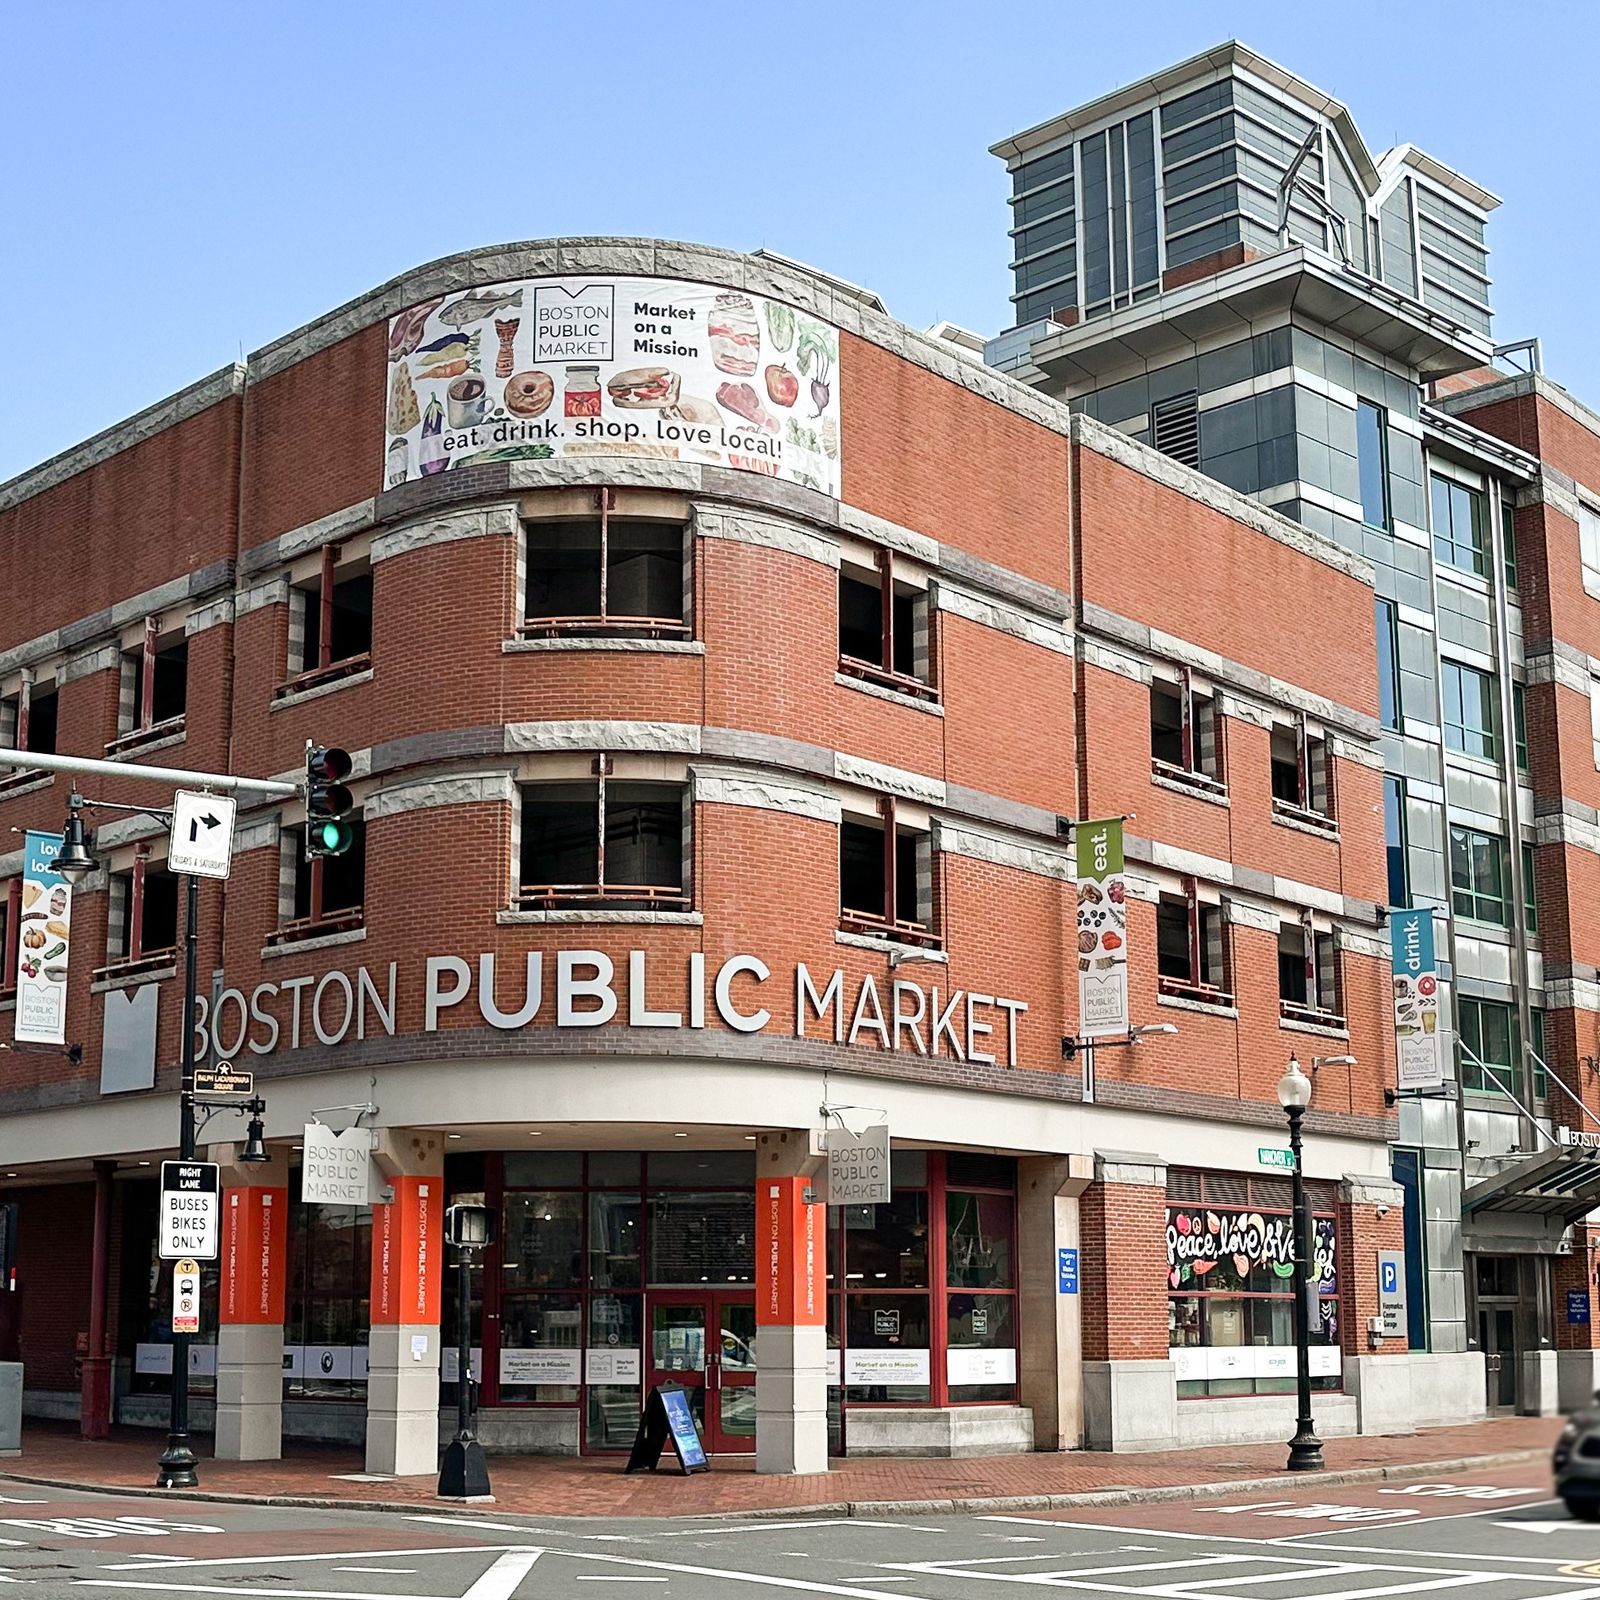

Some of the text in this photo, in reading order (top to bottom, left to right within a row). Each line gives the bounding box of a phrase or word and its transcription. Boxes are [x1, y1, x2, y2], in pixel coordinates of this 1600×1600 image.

[539, 306, 609, 321] BOSTON
[633, 302, 697, 320] Market
[539, 324, 600, 339] PUBLIC
[634, 322, 672, 335] on a
[538, 342, 608, 356] MARKET
[633, 339, 698, 357] Mission
[443, 417, 782, 459] eat. drink. shop. love local!
[40, 841, 61, 856] lov
[1091, 828, 1107, 871] eat.
[1403, 916, 1421, 971] drink.
[1087, 986, 1120, 997] BOSTON
[25, 995, 59, 1006] BOSTON
[181, 950, 1028, 1066] BOSTON PUBLIC MARKET
[1088, 997, 1116, 1006] PUBLIC
[25, 1005, 54, 1014] PUBLIC
[1087, 1006, 1120, 1016] MARKET
[24, 1014, 57, 1024] MARKET
[308, 1145, 366, 1162] BOSTON
[831, 1147, 886, 1163] BOSTON
[179, 1167, 202, 1177] RIGHT
[308, 1164, 358, 1180] PUBLIC
[832, 1165, 879, 1181] PUBLIC
[180, 1179, 201, 1189] LANE
[307, 1182, 365, 1199] MARKET
[831, 1183, 886, 1199] MARKET
[170, 1197, 208, 1211] BUSES
[172, 1216, 206, 1230] BIKES
[771, 1200, 779, 1239] BOSTON
[172, 1235, 205, 1248] ONLY
[1166, 1225, 1218, 1265] Peace,
[1219, 1215, 1262, 1259] love
[417, 1199, 427, 1315] BOSTON PUBLIC MARKET
[771, 1241, 779, 1275] PUBLIC
[184, 1263, 191, 1271] T
[1385, 1266, 1394, 1288] P
[261, 1279, 269, 1315] MARKET
